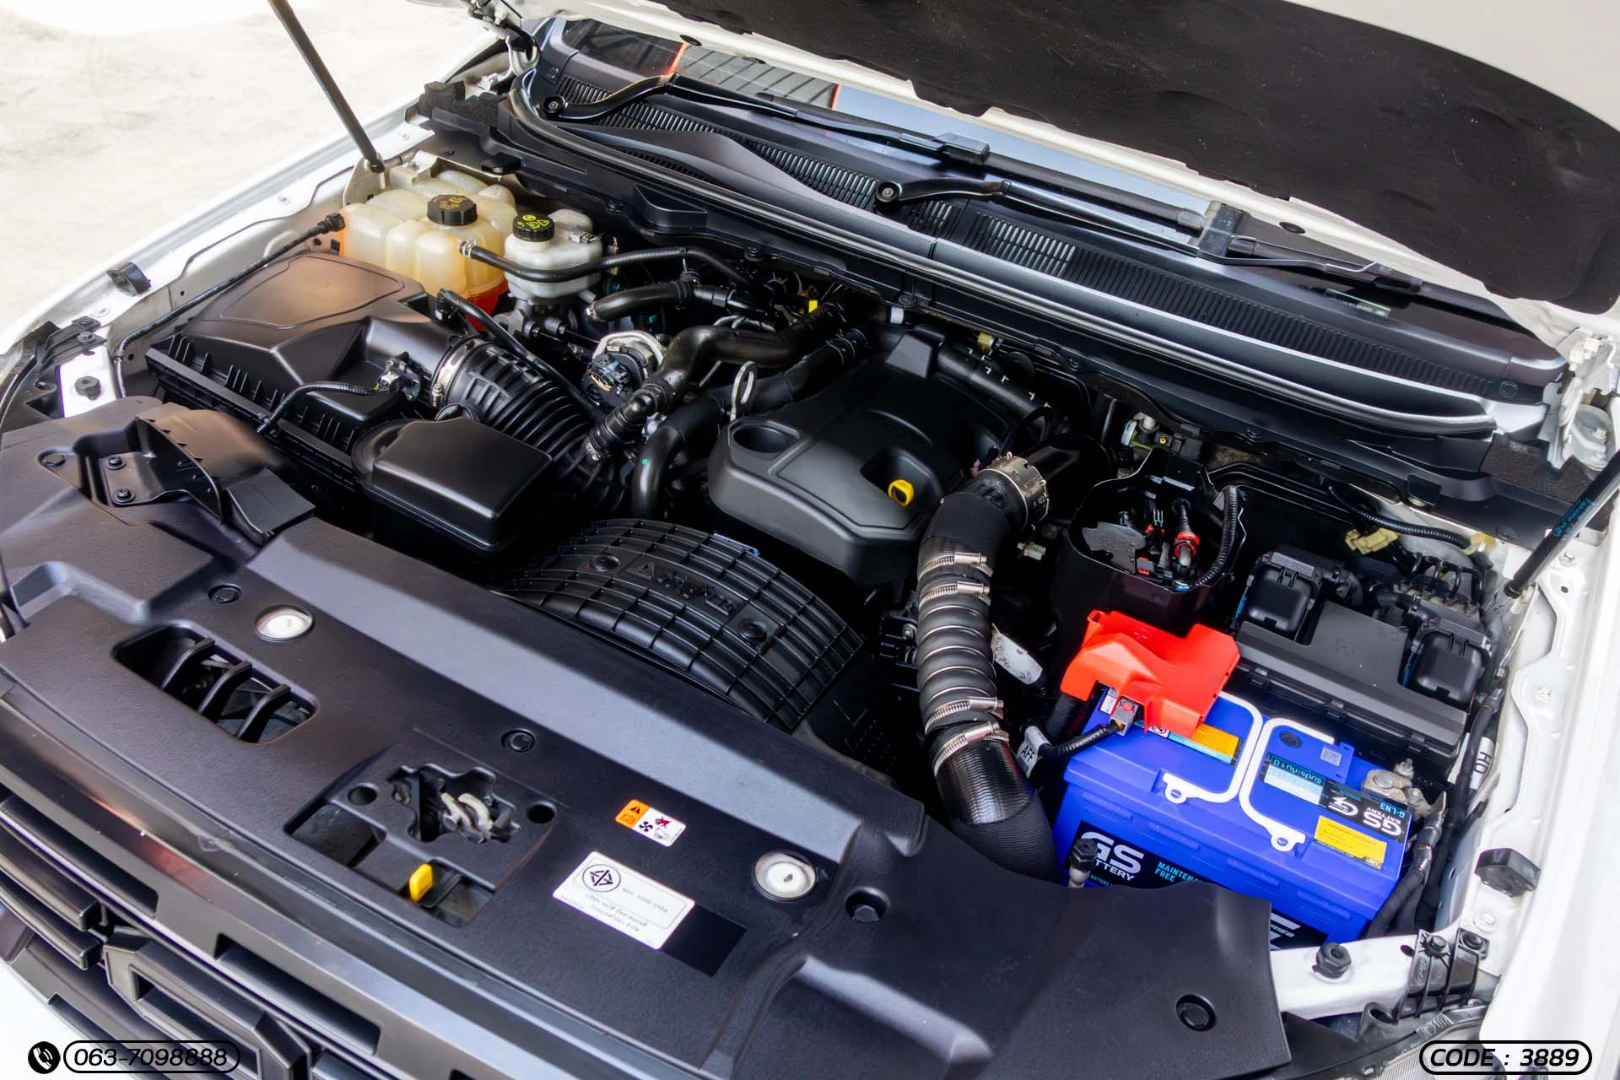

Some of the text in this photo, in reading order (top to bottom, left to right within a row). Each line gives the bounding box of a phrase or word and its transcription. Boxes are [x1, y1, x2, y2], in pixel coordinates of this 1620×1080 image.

[1363, 809, 1403, 836] GS
[1366, 806, 1401, 824] BATTERY
[1095, 859, 1135, 881] TTERY
[1154, 868, 1176, 882] FREE
[1157, 861, 1198, 881] MAINTEN
